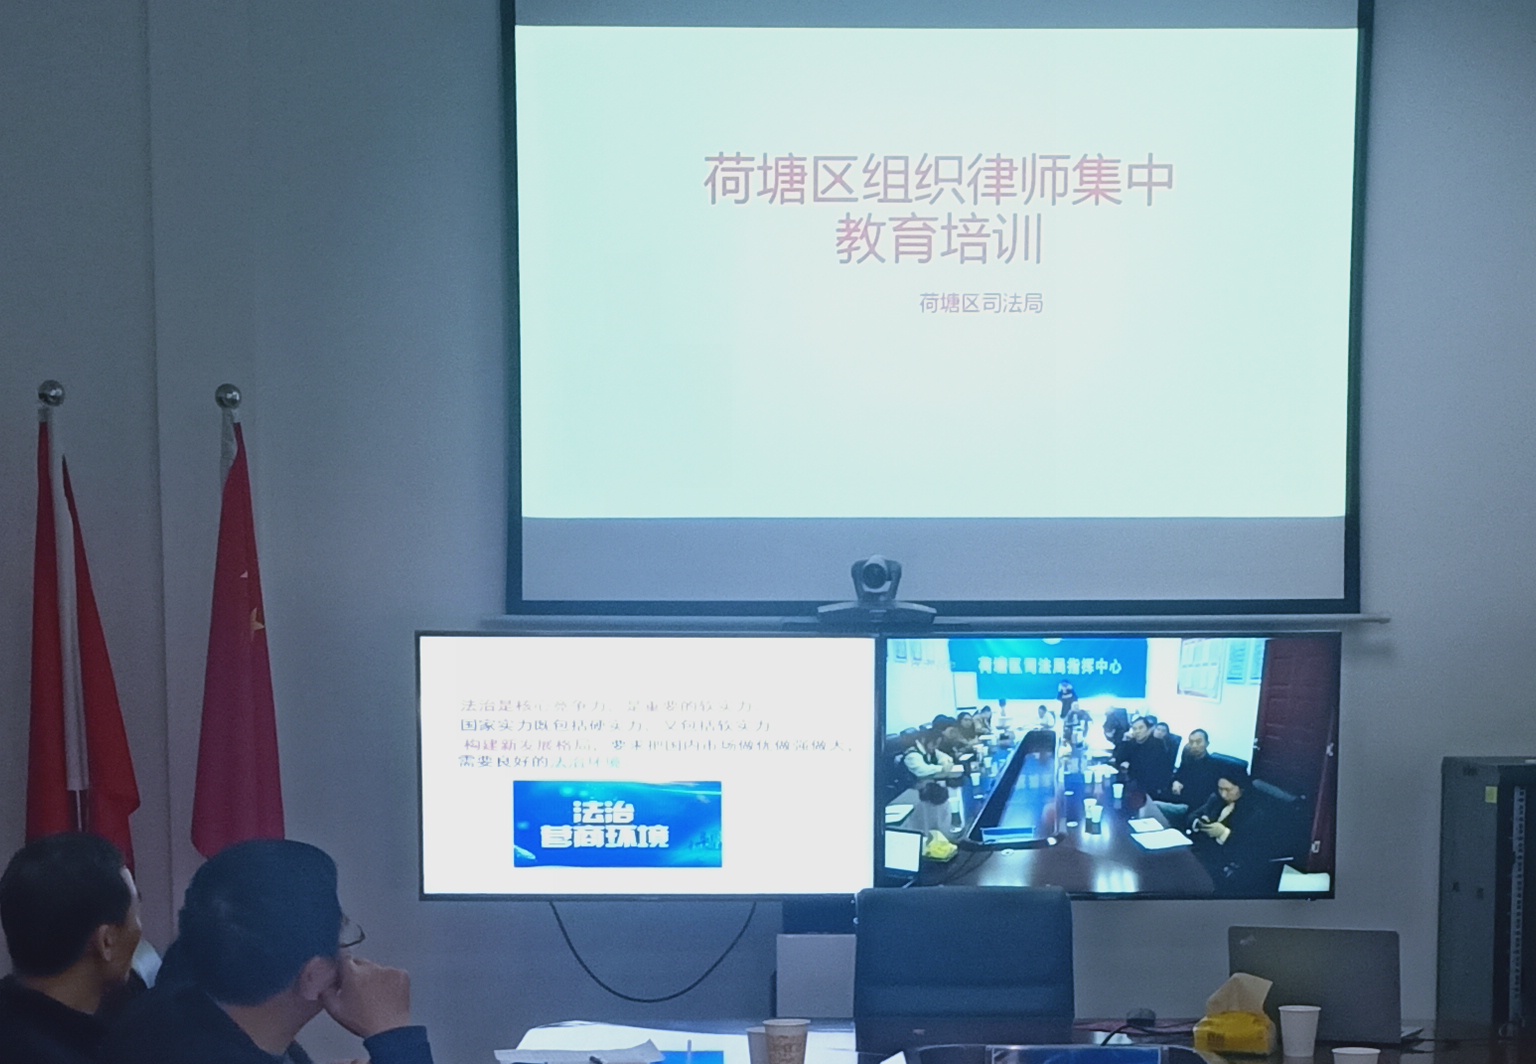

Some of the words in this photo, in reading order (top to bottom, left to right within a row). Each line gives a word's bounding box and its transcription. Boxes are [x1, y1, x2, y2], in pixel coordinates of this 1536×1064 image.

[703, 152, 1177, 208] 荷塘区组织律师集中
[834, 211, 1044, 267] 教育培训
[918, 291, 1045, 316] 荷塘区司法局
[978, 656, 1122, 675] 荷塘区司法局指挥中心
[572, 801, 635, 824] 法治
[540, 824, 670, 849] 营商环境
